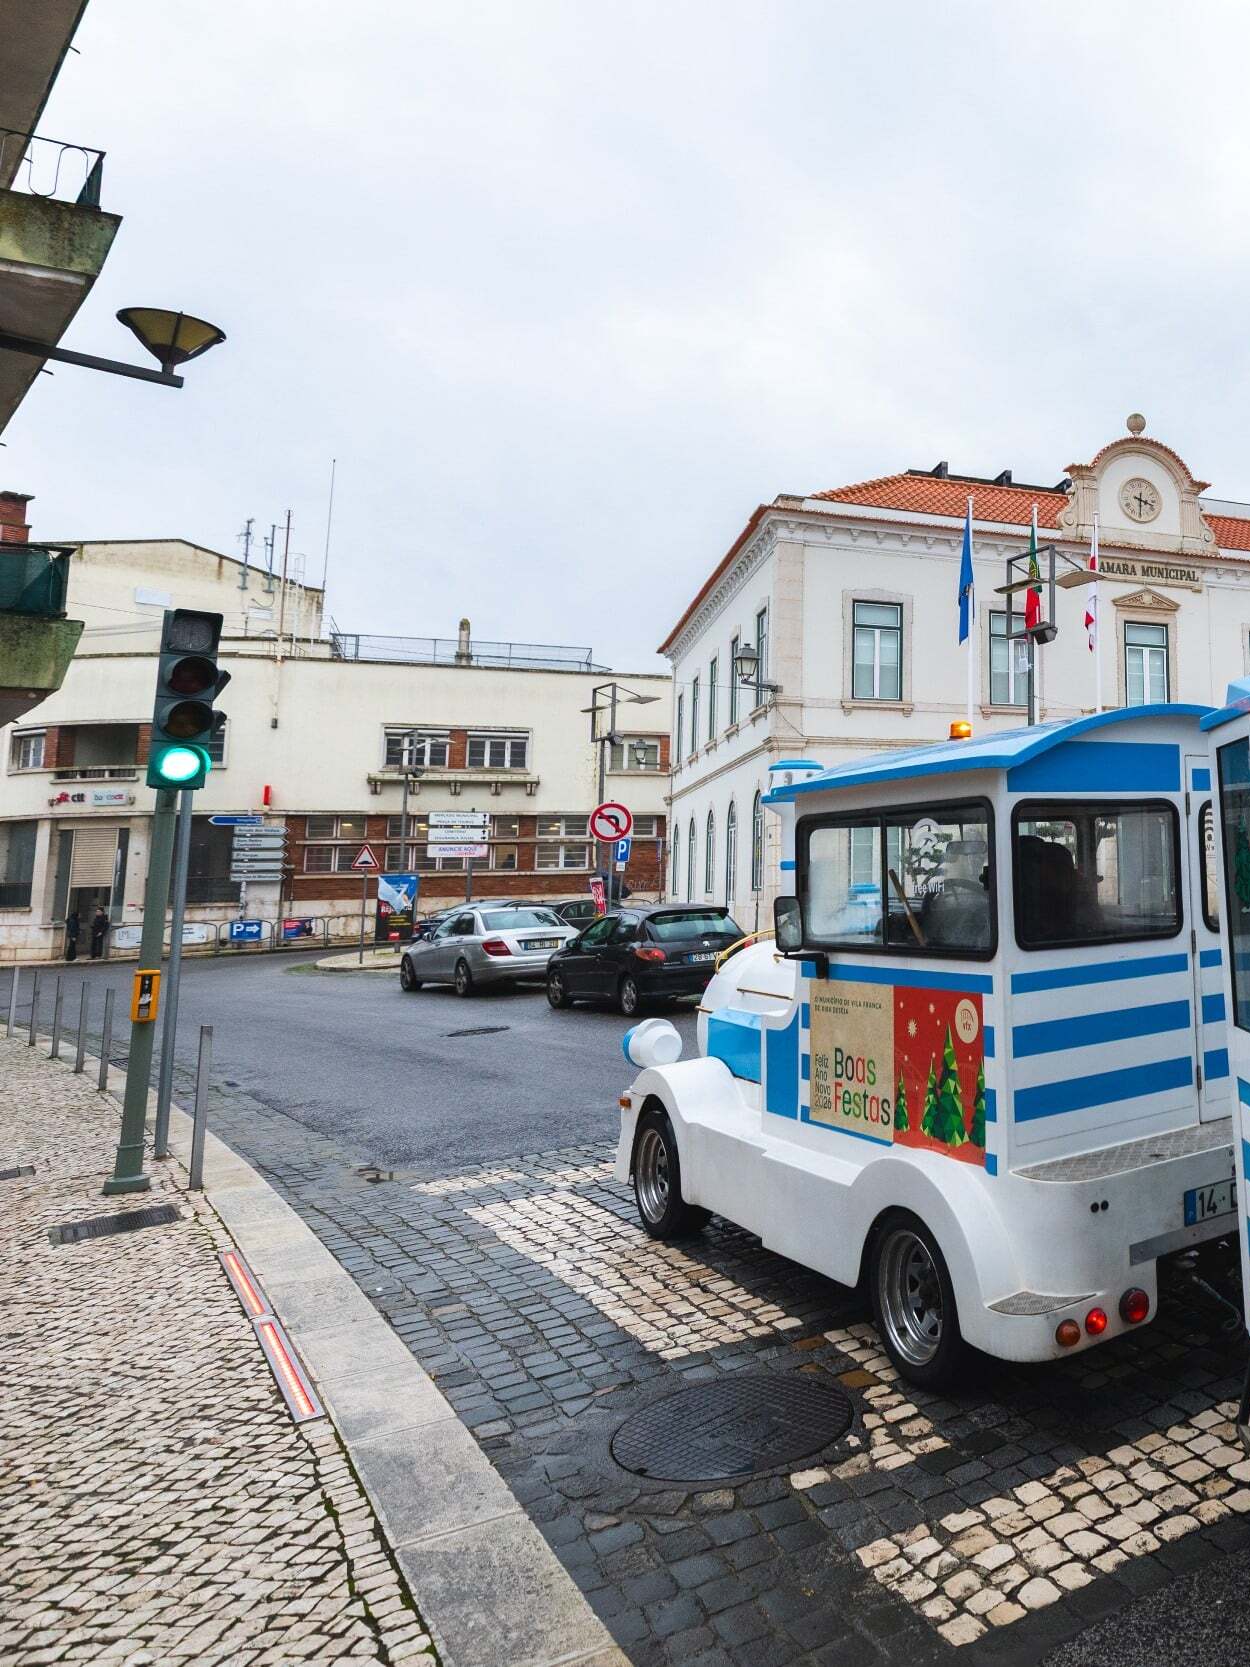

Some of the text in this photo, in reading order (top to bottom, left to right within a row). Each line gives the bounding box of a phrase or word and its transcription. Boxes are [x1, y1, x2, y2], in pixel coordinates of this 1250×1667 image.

[1099, 560, 1200, 583] AMARA MUNICIPAL
[617, 840, 627, 860] P
[232, 924, 245, 936] P
[815, 1068, 828, 1082] Ano
[834, 1047, 877, 1086] Boas
[815, 1081, 831, 1096] Novo
[834, 1081, 891, 1126] Festas
